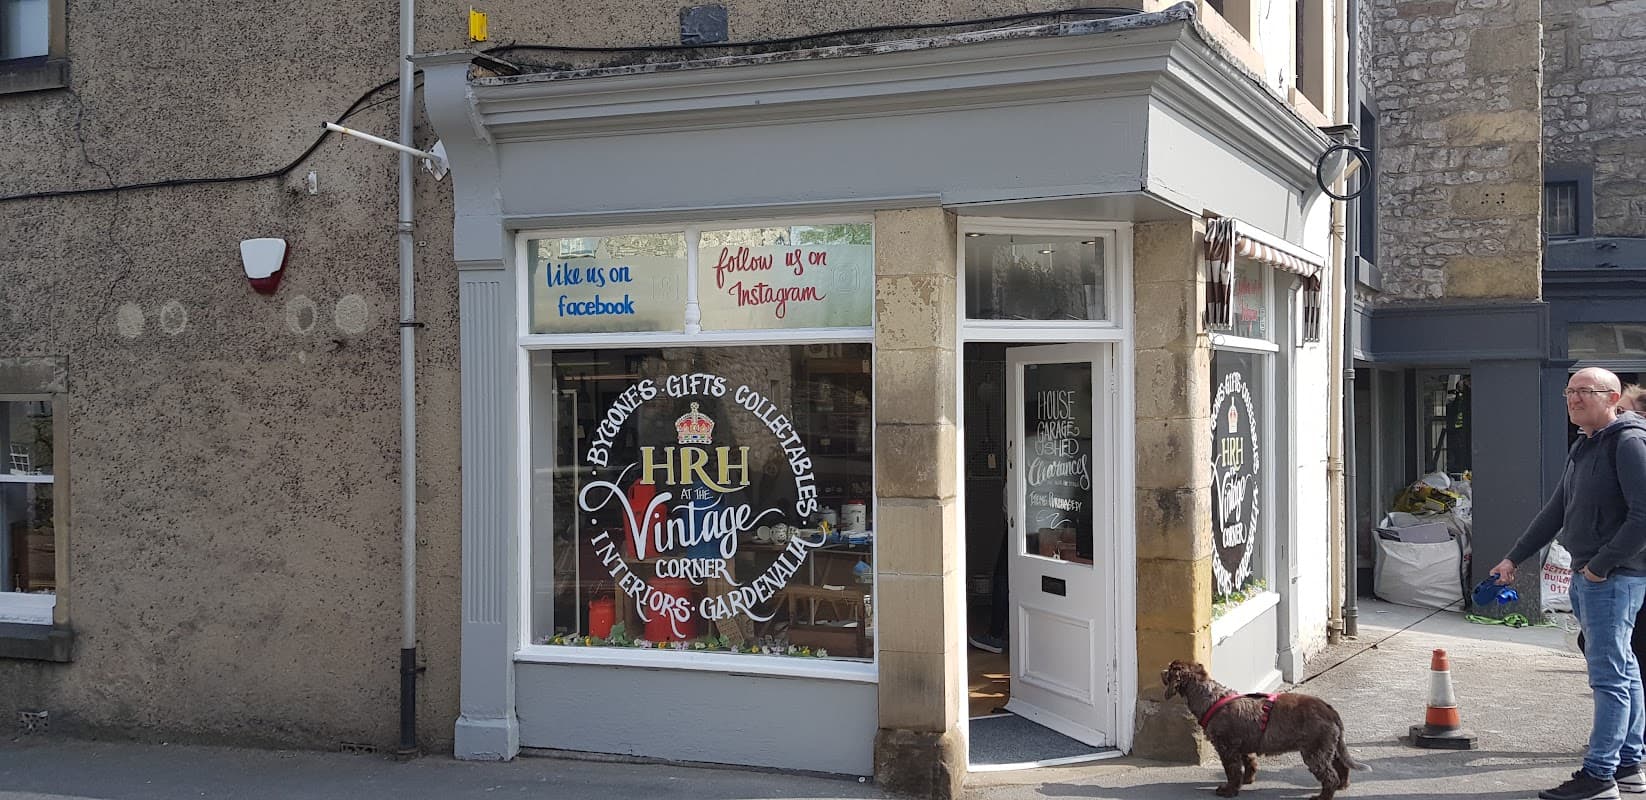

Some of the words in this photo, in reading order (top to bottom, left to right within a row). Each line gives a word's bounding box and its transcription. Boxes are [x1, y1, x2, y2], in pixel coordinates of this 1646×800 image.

[547, 262, 582, 287] like
[586, 266, 605, 286] us
[609, 265, 632, 283] on
[712, 246, 774, 289] follow
[786, 249, 804, 275] us
[808, 250, 828, 266] on
[558, 294, 634, 317] facebook
[729, 280, 826, 319] Instagram
[1037, 390, 1076, 420] HOUSE
[586, 379, 658, 468] BYGONES
[665, 373, 727, 398] GIFTS
[735, 384, 818, 518] COLLECTABLES
[1037, 420, 1080, 441] GARAGE
[640, 446, 750, 493] HRH
[1028, 454, 1090, 490] Clearances
[1221, 437, 1244, 472] HRH
[579, 462, 785, 560] Vintage
[680, 489, 692, 501] AT
[694, 488, 713, 501] THE
[591, 530, 690, 639] INTERIORS
[700, 525, 827, 622] GARDENALIA
[655, 558, 742, 586] CORNER
[1550, 583, 1568, 594] 017
